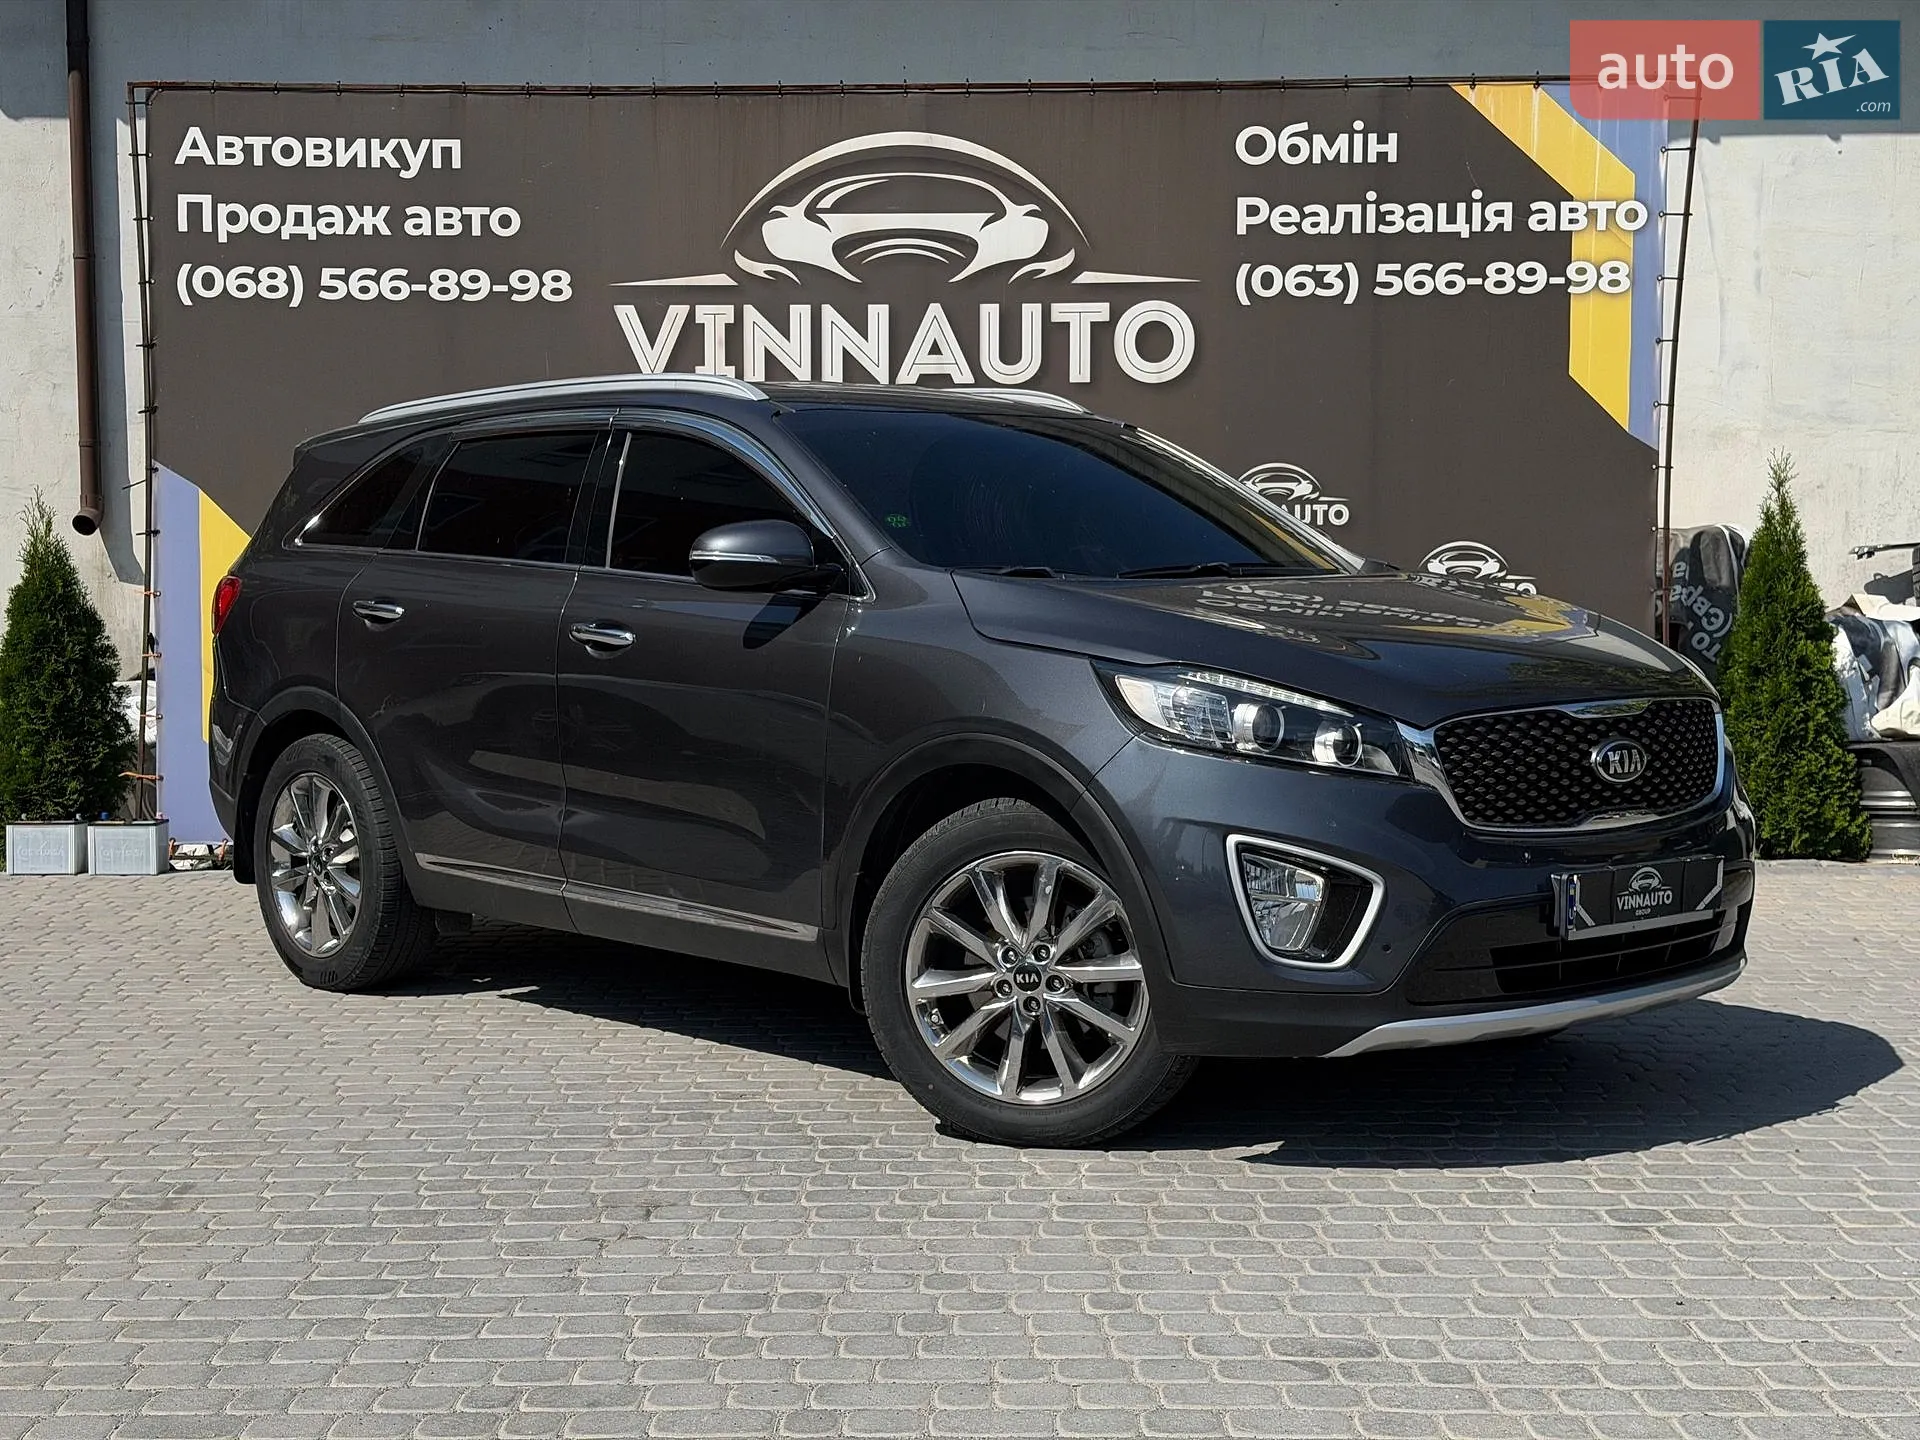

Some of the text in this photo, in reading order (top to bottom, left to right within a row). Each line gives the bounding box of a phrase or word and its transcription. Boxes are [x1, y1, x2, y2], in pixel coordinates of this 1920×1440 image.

[175, 127, 461, 180] Автовикуп
[1235, 121, 1398, 166] Обмін
[177, 194, 521, 243] Продаж авто
[1236, 190, 1649, 239] Реалізація авто
[176, 264, 573, 308] (068) 566-89-98
[1235, 261, 1631, 306] (063) 566-89-98
[614, 301, 1196, 385] VINNAUTO
[1609, 748, 1642, 775] KIA
[1616, 889, 1673, 911] VINNAUTO
[1016, 973, 1039, 984] KIA
